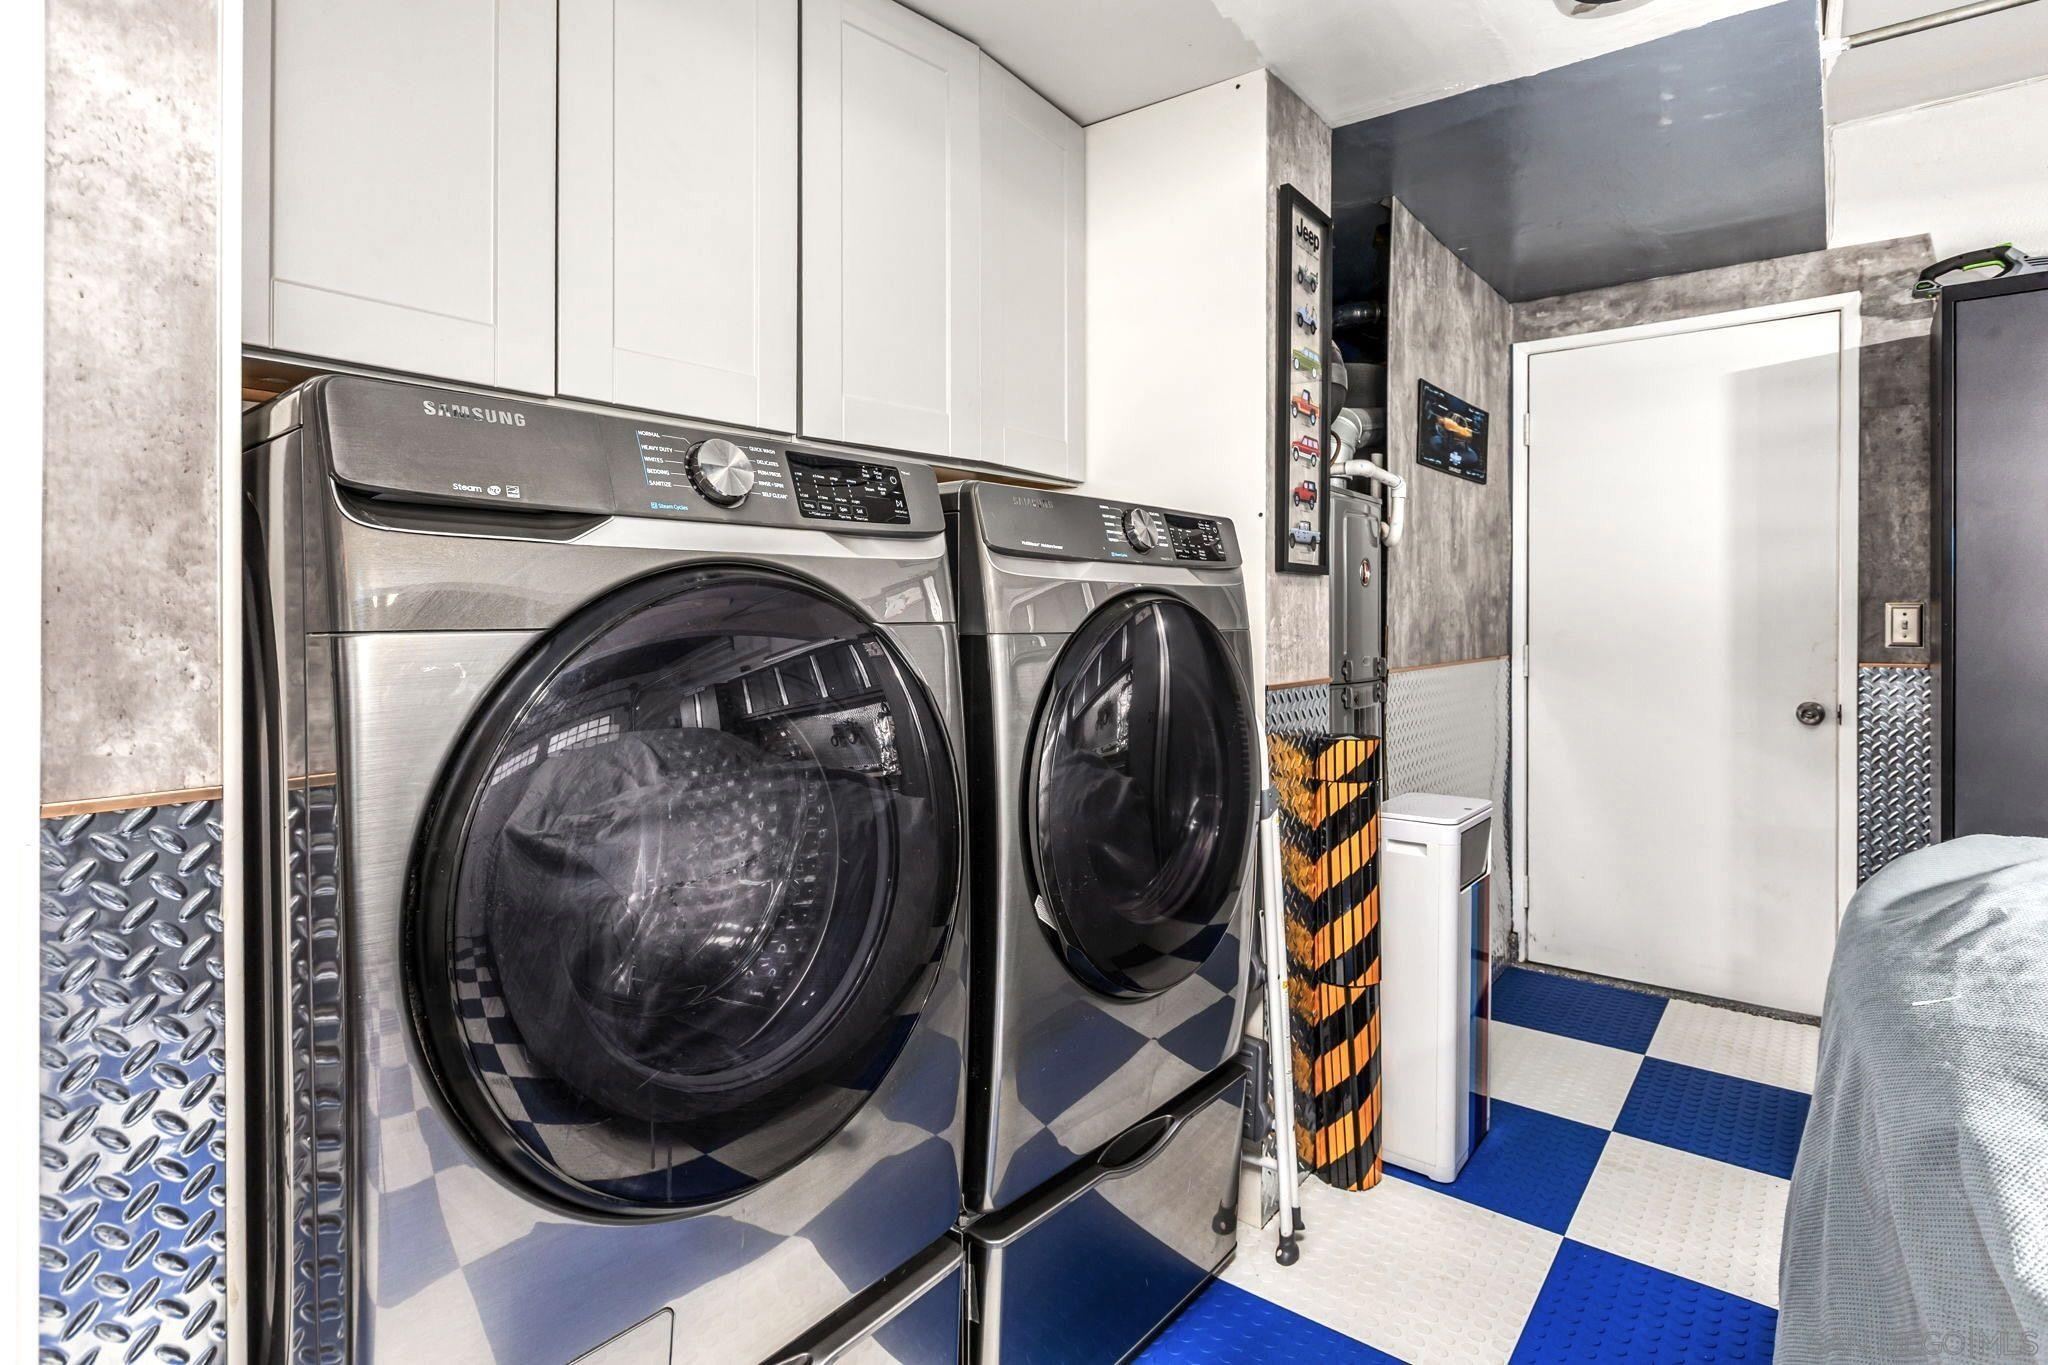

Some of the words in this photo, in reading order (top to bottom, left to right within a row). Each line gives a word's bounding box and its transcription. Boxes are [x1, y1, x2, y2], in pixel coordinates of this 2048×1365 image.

[1296, 218, 1320, 252] Jeep
[423, 400, 526, 427] SAMSUNG
[637, 430, 660, 438] NORMAL
[647, 468, 670, 476] BEDDING
[452, 482, 483, 493] Steam
[649, 480, 672, 488] SANITIZE
